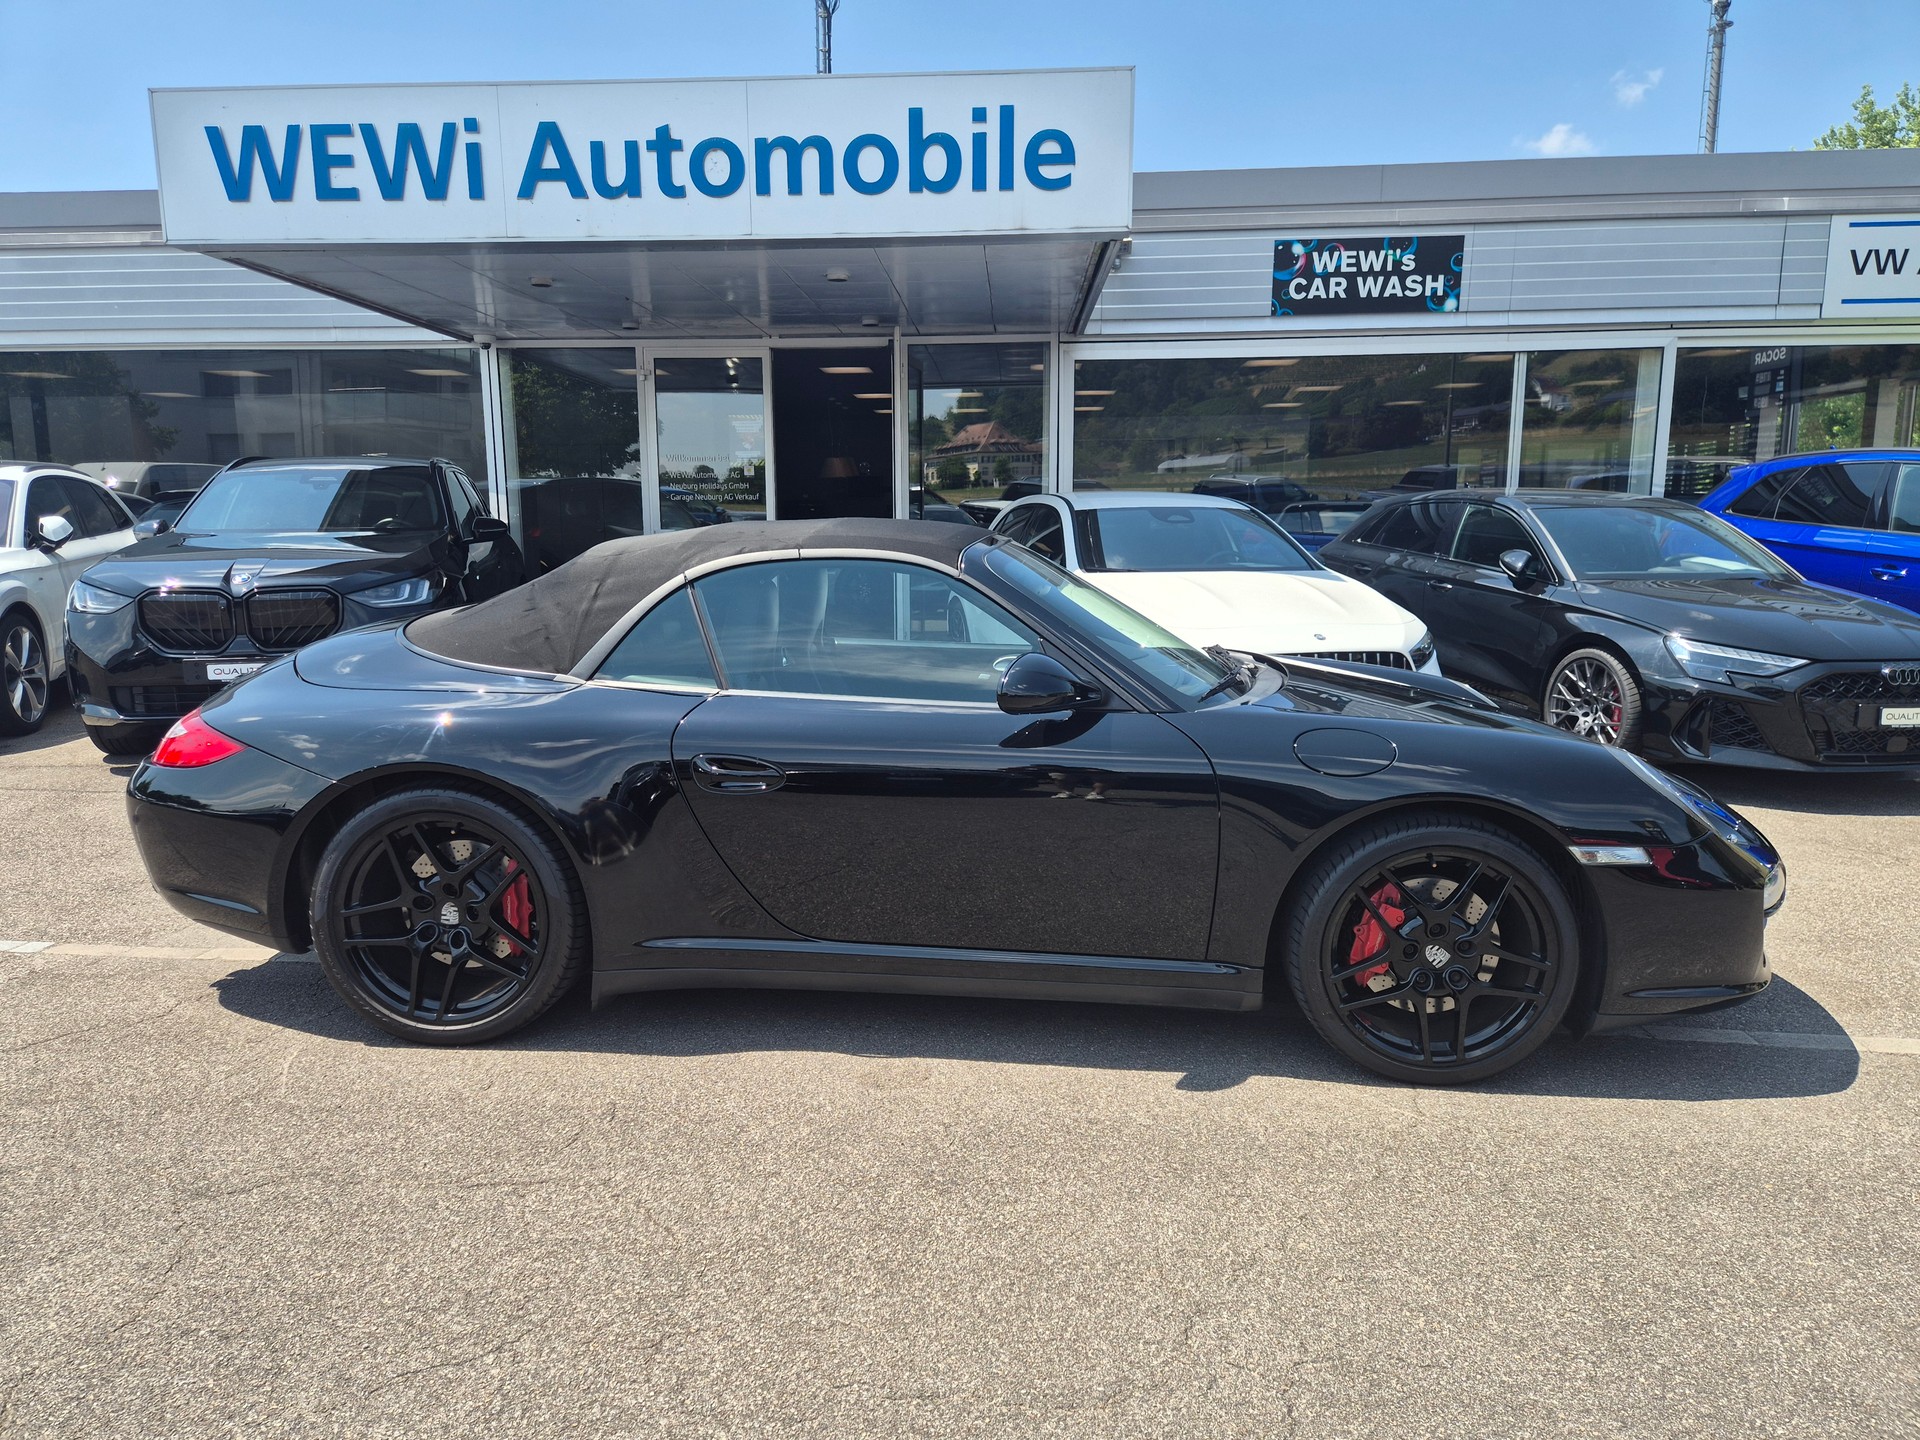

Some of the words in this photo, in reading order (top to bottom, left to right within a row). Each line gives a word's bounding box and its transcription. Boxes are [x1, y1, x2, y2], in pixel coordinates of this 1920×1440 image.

[204, 117, 485, 202] WEWi
[517, 104, 1077, 199] Automobile
[1312, 248, 1416, 273] WEWi's
[1850, 248, 1910, 275] VW
[1288, 277, 1348, 300] CAR
[1356, 274, 1445, 298] WASH
[670, 482, 698, 491] Neuburg
[699, 482, 728, 491] Holidays
[728, 482, 750, 490] GmbH
[730, 471, 741, 479] AG
[670, 493, 694, 502] Garage
[695, 493, 723, 502] Neuburg
[723, 493, 734, 501] AG
[734, 493, 760, 501] Verkauf
